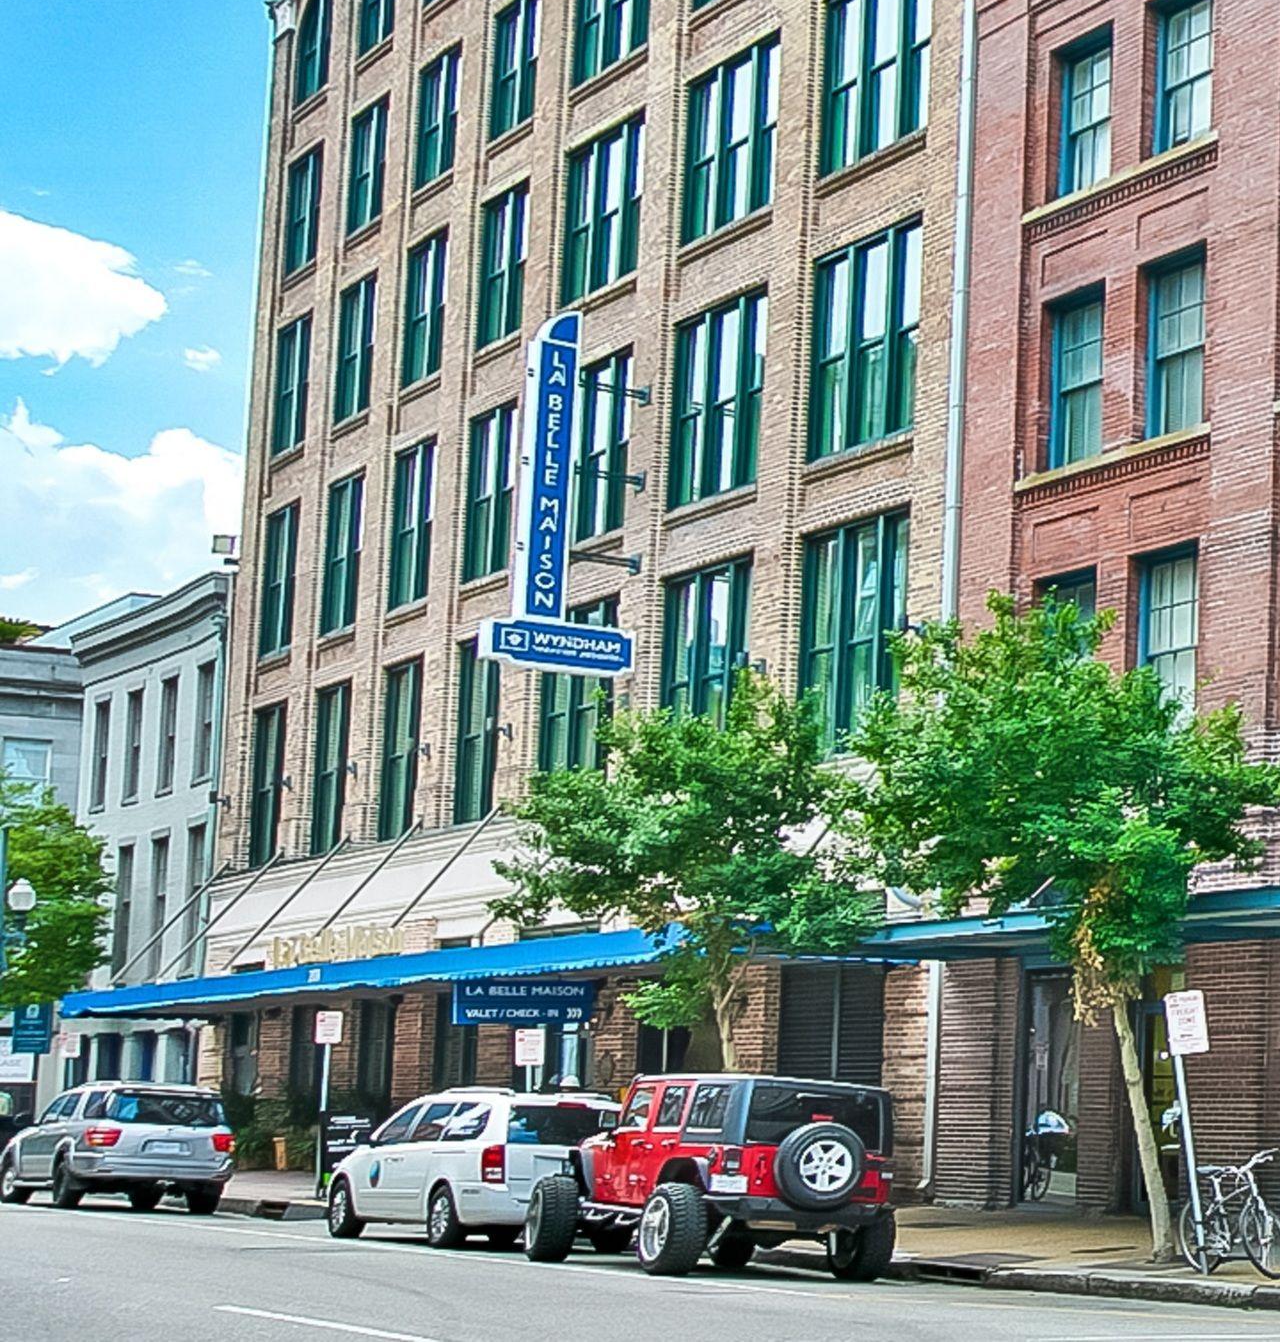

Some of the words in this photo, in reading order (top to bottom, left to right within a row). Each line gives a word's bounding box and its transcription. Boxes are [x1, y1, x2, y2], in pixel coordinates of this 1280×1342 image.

[548, 350, 567, 387] LA
[544, 393, 563, 486] BELLE
[534, 495, 560, 609] MAISON
[532, 630, 622, 654] WYNDHAM
[464, 985, 485, 997] LA
[488, 985, 528, 997] BELLE
[530, 985, 586, 997] MAISON
[464, 1008, 498, 1019] VALET
